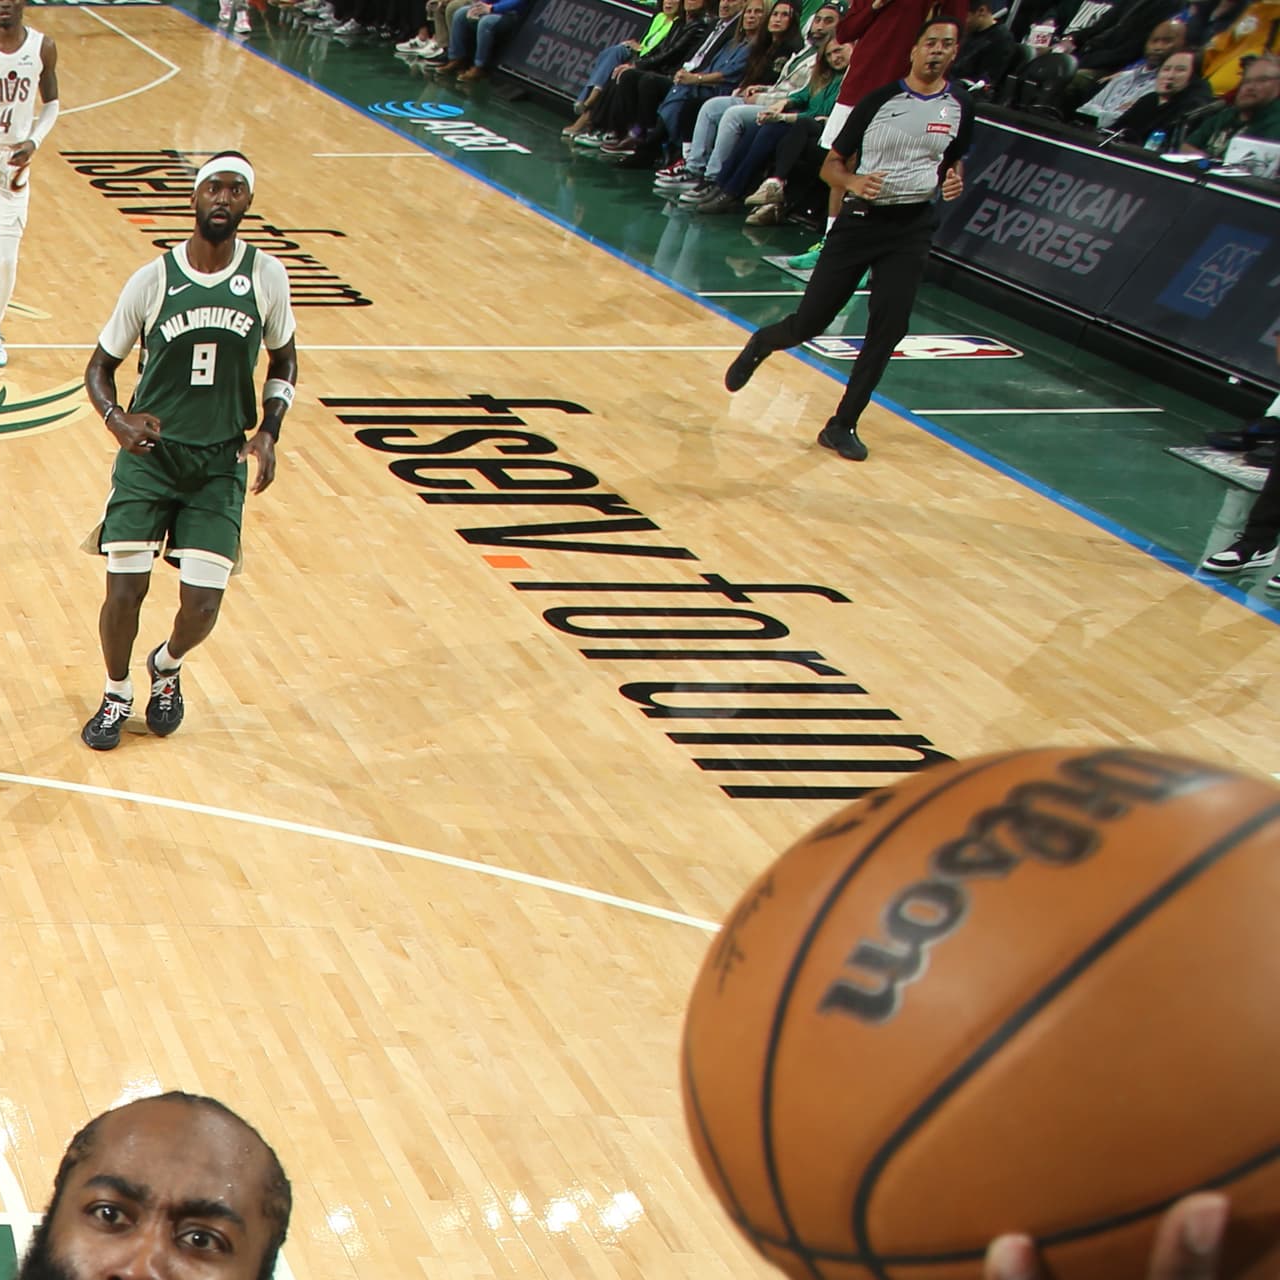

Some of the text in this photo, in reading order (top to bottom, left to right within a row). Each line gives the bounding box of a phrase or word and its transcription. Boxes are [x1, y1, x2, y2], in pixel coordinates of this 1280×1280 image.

[536, 0, 639, 50] AMERICAN
[526, 36, 594, 83] EXPRES
[409, 119, 532, 154] AT&T
[973, 154, 1144, 234] AMERICAN
[963, 198, 1113, 276] EXPRESS
[160, 307, 254, 342] MILWAUKEE
[191, 343, 217, 386] 9
[819, 748, 1236, 1023] Wilson
